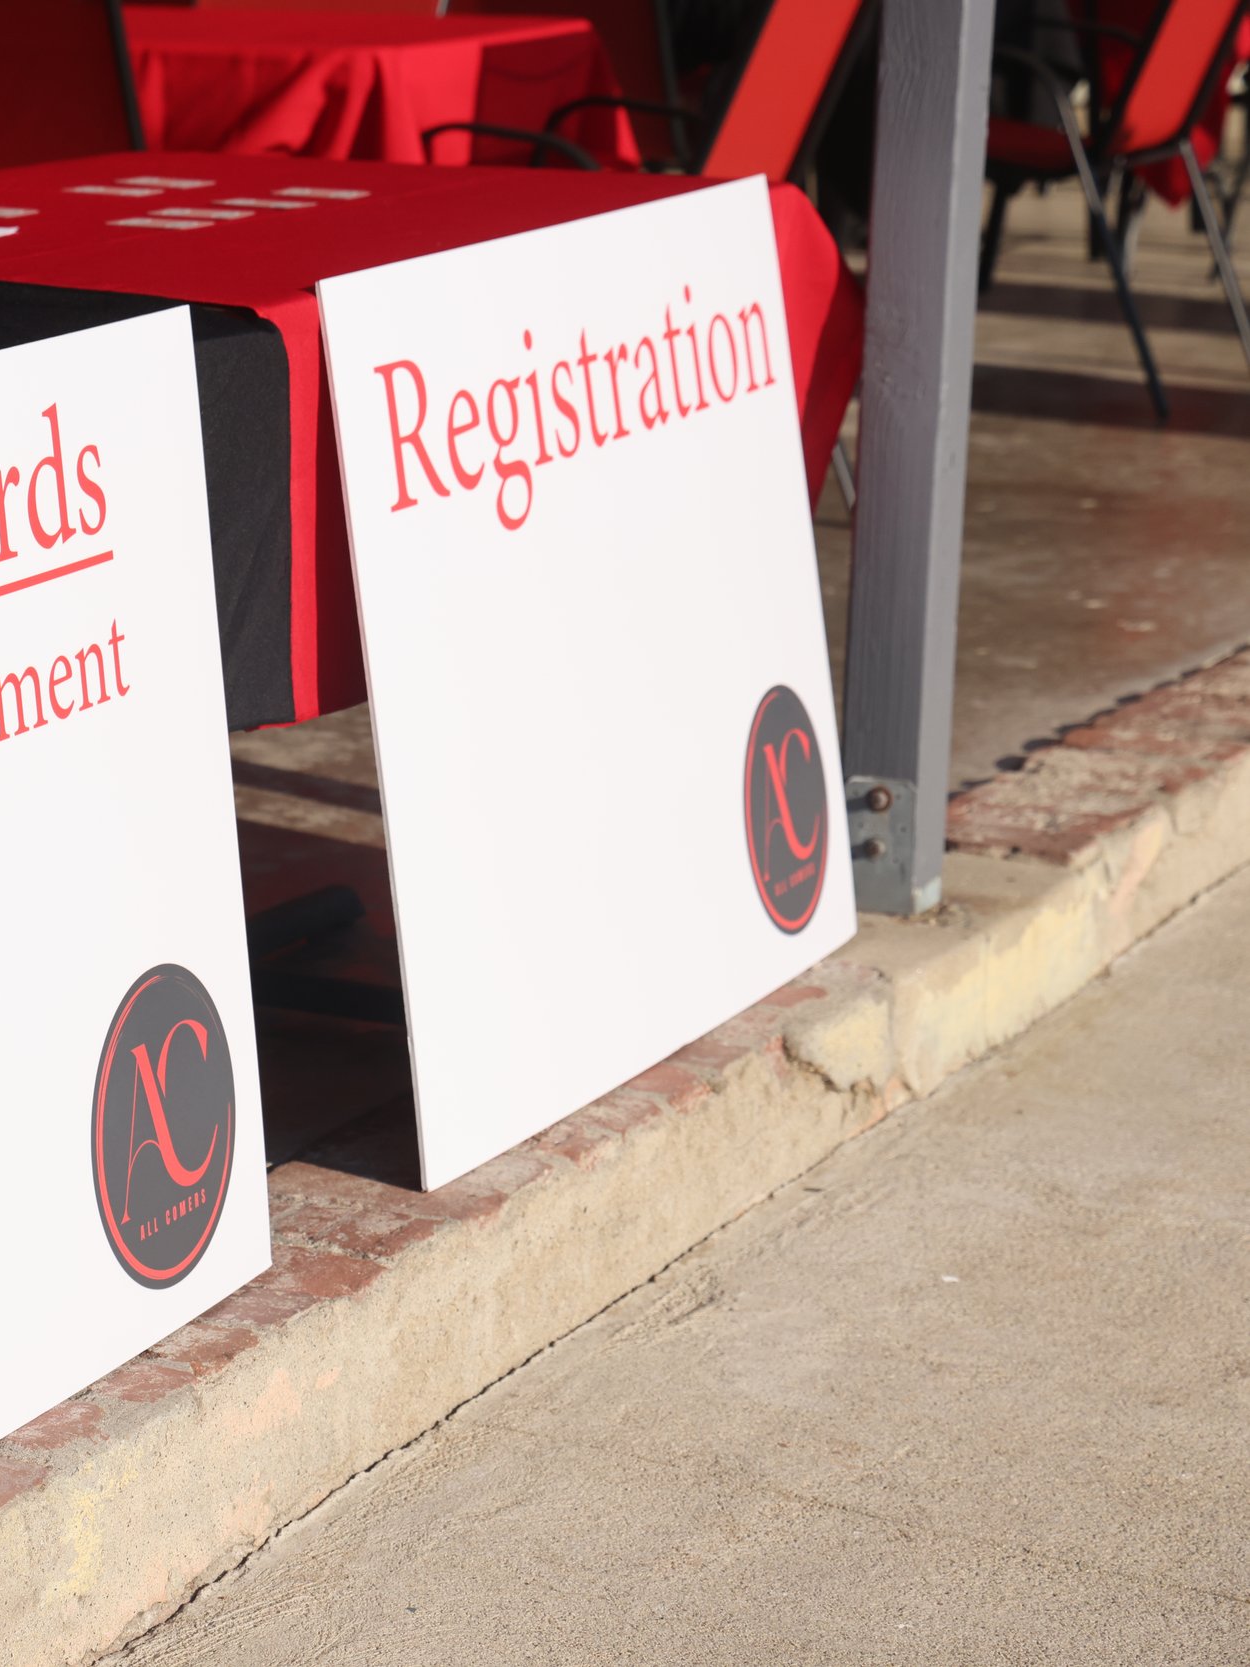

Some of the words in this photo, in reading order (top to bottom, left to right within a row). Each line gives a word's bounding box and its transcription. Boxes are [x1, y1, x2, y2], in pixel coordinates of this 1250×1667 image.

[373, 284, 776, 531] Registration
[764, 728, 820, 882] AC
[121, 1019, 218, 1225] AC
[140, 1217, 159, 1241] ALL
[165, 1188, 206, 1225] COMERS
